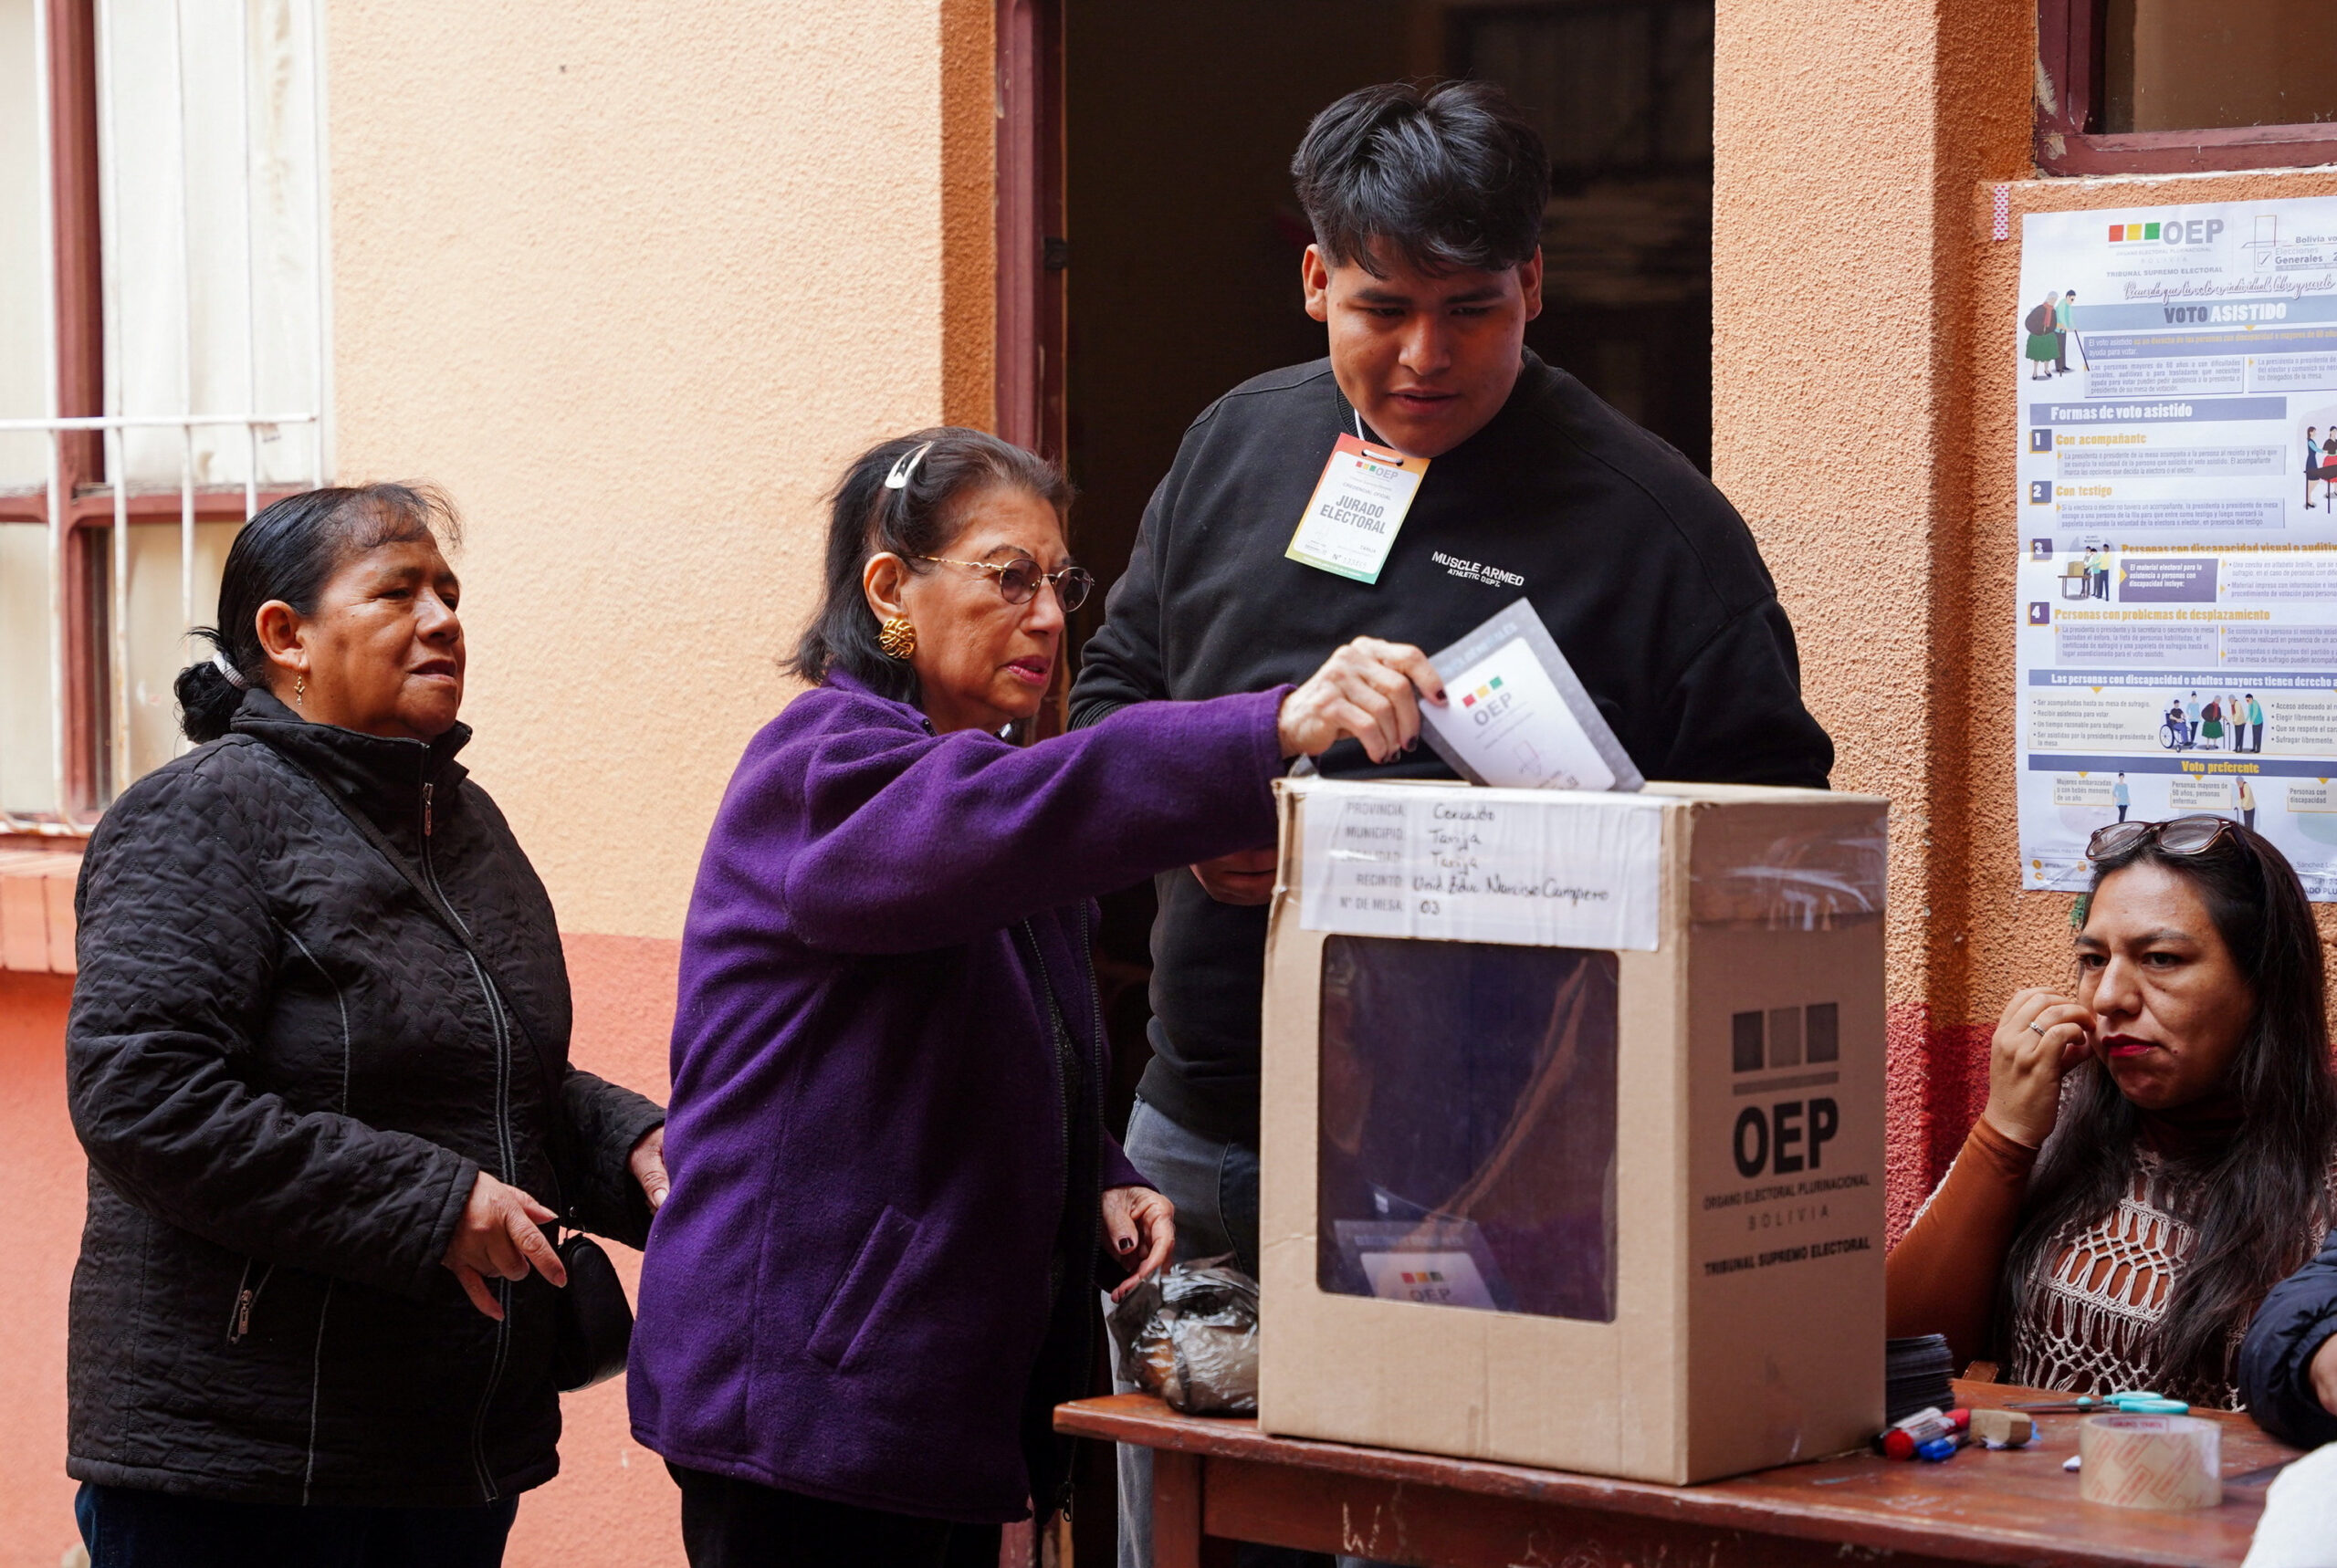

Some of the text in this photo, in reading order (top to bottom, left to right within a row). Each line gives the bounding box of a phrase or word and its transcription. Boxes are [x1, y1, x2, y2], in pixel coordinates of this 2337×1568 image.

[2163, 219, 2225, 245] OEP
[2295, 235, 2325, 244] Bolivia
[2276, 247, 2319, 256] Elecciones
[2275, 254, 2323, 265] Generales
[2143, 268, 2179, 277] SUPREMO
[2164, 302, 2287, 324] VOTO ASISTIDO
[2050, 402, 2193, 420] Formas de voto asistido
[2034, 432, 2041, 446] 1
[2056, 433, 2147, 446] Con acompañante
[1376, 466, 1399, 481] OEP
[2033, 485, 2042, 497] 2
[2056, 484, 2112, 498] Con testigo
[1336, 495, 1385, 518] JURADO
[1319, 504, 1387, 535] ELECTORAL
[2034, 542, 2043, 555] 3
[2259, 542, 2291, 551] visual
[1431, 550, 1525, 587] MUSCLE ARMED
[1447, 568, 1481, 580] ATHLETIC
[2032, 605, 2041, 620] 4
[2055, 608, 2271, 622] Personas con problemas de desplazamiento
[2051, 674, 2068, 684] Las
[2069, 674, 2108, 685] personas
[2109, 675, 2126, 685] con
[2126, 674, 2183, 686] discapacidad
[2190, 674, 2223, 686] adultos
[2224, 677, 2263, 687] mayores
[2264, 676, 2293, 686] tienen
[2294, 676, 2332, 686] derecho
[1472, 692, 1513, 727] OEP
[2181, 760, 2260, 774] Voto preferente
[1428, 828, 1483, 852] Tarija
[1430, 850, 1479, 875] Tarija
[1420, 900, 1441, 915] 03
[1732, 1097, 1839, 1178] OEP
[1702, 1173, 1871, 1211] ÓRGANO ELECTORAL PLURINACIONAL
[1747, 1205, 1830, 1230] BOLIVIA
[1704, 1236, 1871, 1278] TRIBUNAL SUPREMO ELECTORAL
[1410, 1288, 1451, 1303] OEP
